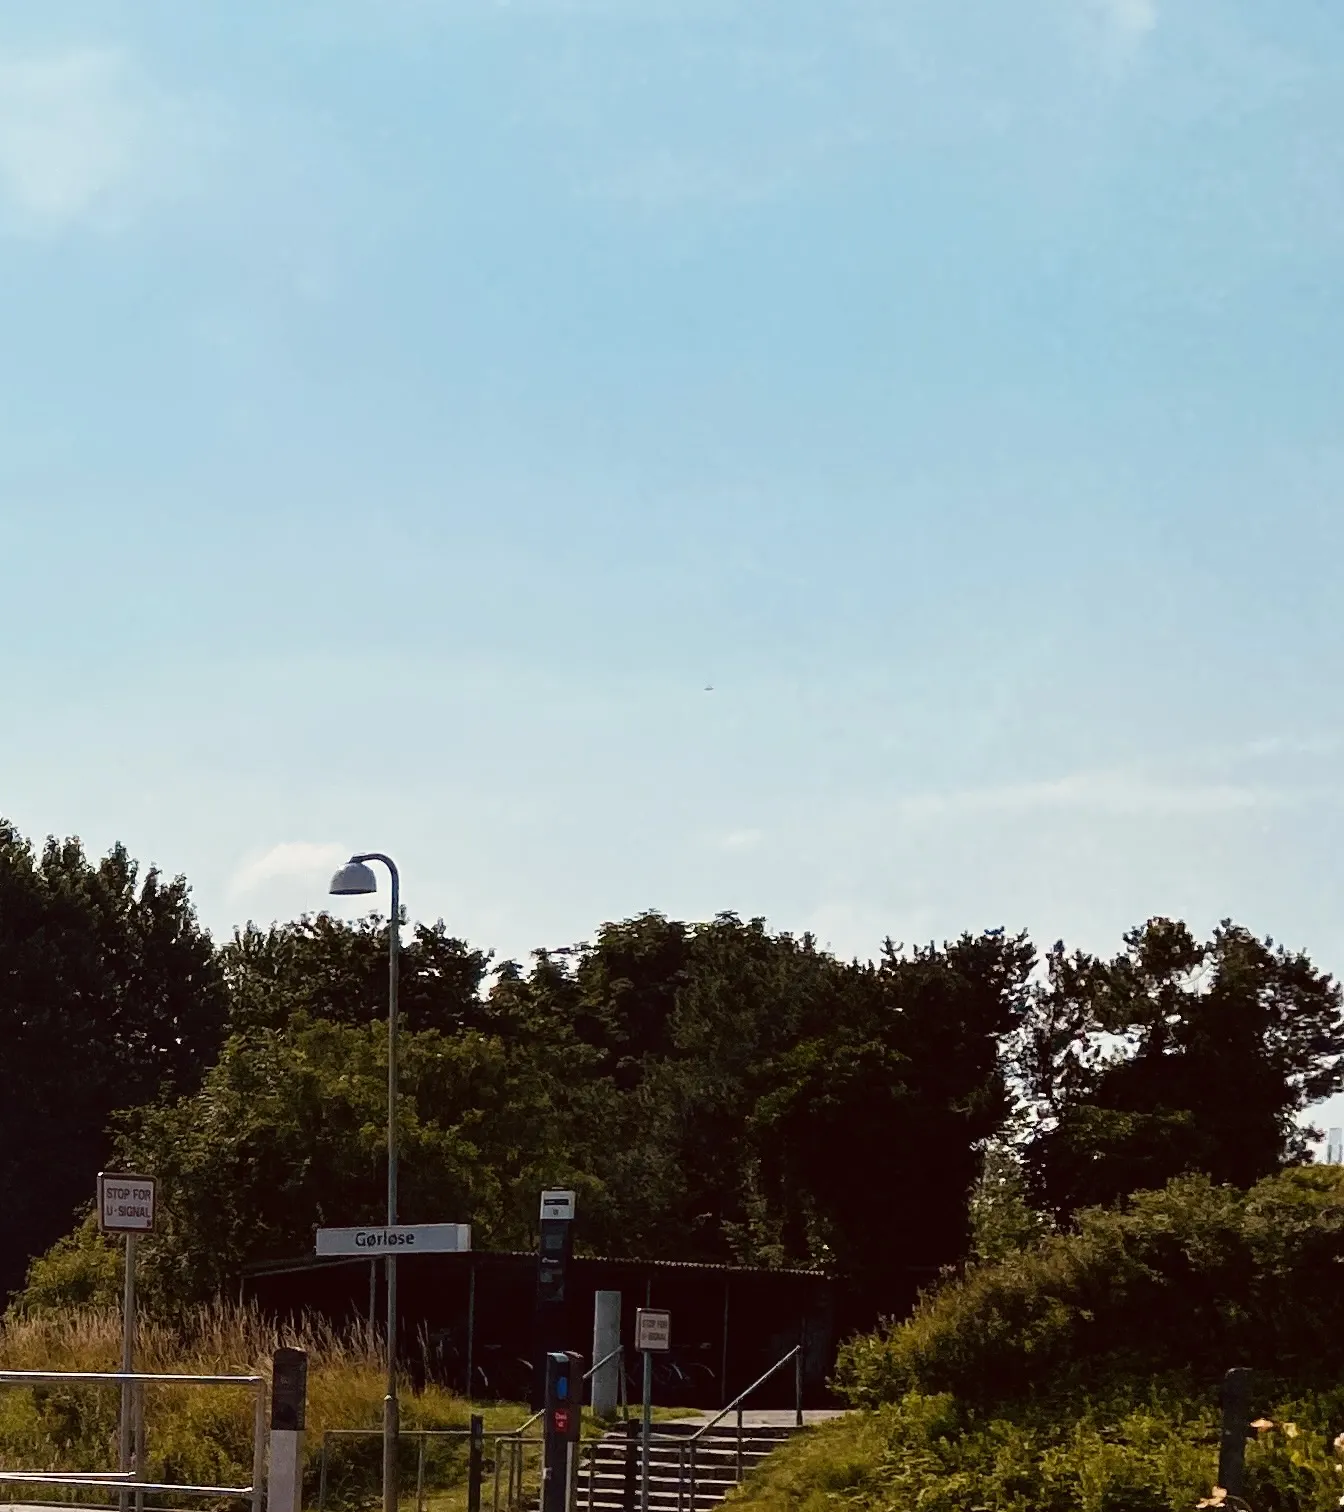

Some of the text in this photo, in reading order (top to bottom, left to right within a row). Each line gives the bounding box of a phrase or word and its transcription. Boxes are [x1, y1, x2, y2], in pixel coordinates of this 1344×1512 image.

[107, 1187, 151, 1201] STOP FOR
[355, 1230, 415, 1247] Gørløse
